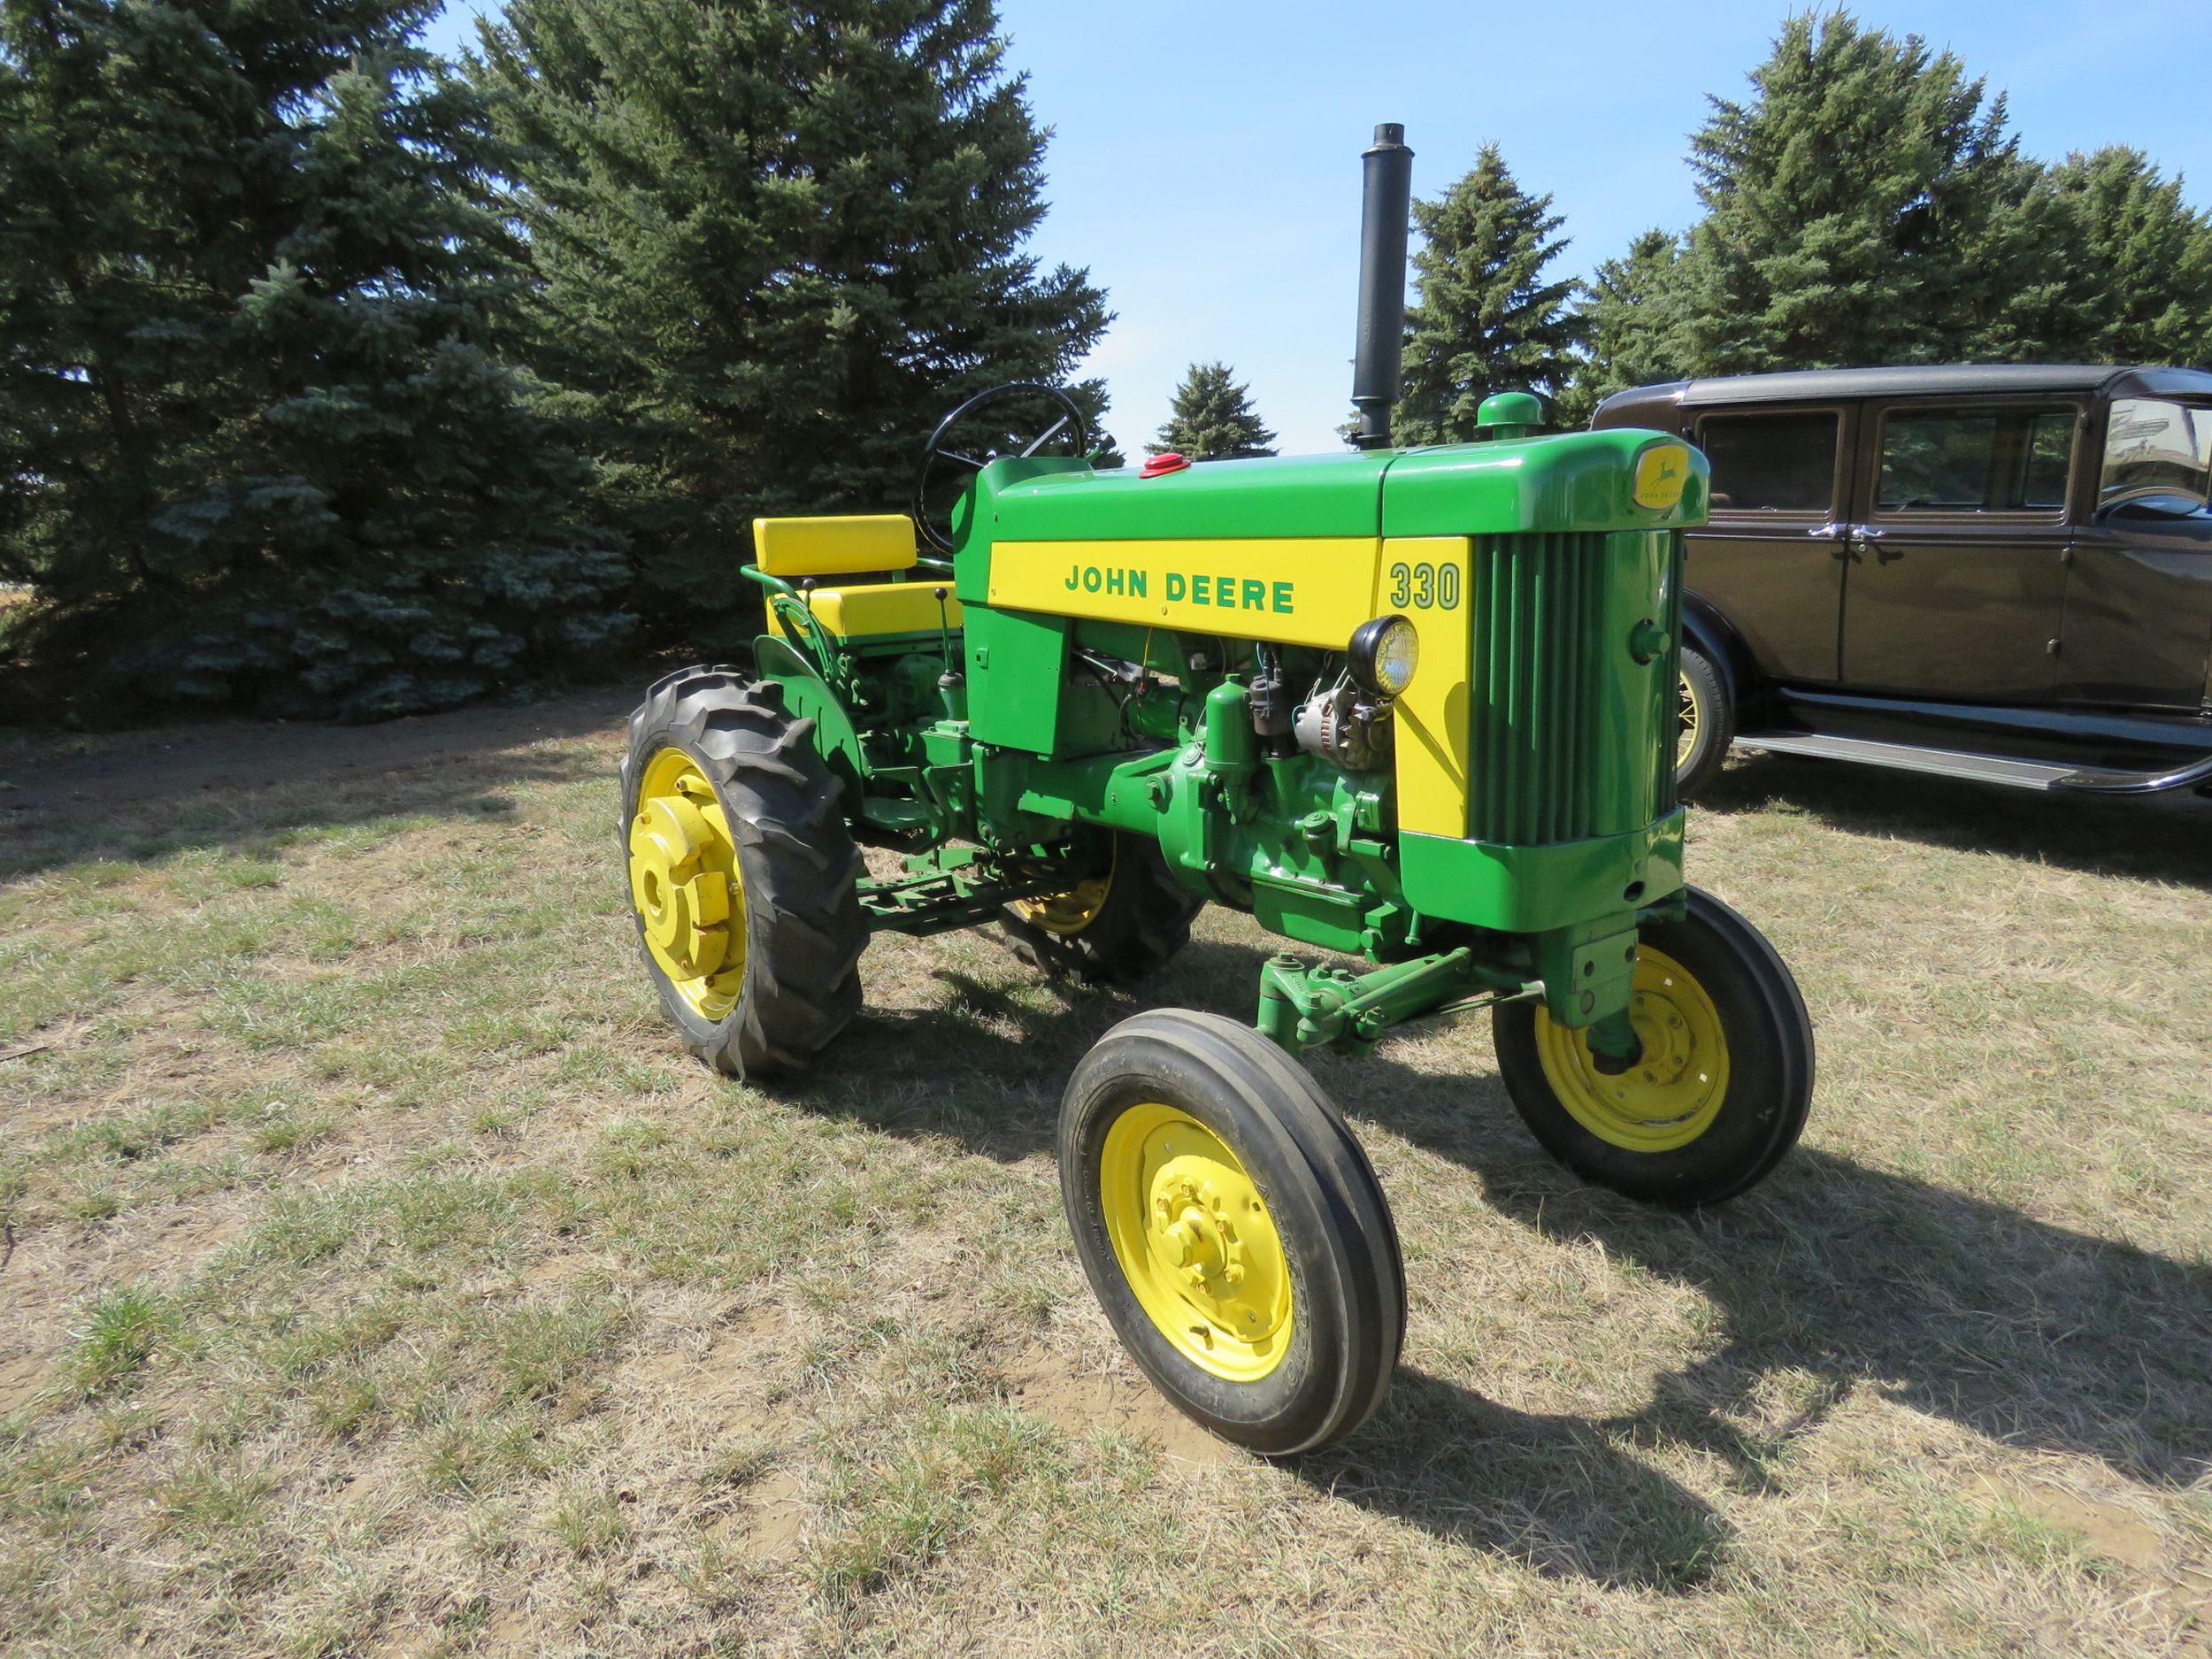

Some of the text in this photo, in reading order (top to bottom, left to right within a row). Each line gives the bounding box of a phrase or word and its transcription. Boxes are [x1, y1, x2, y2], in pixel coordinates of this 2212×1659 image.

[1064, 565, 1294, 614] JOHN DEERE
[1390, 562, 1460, 611] 330
